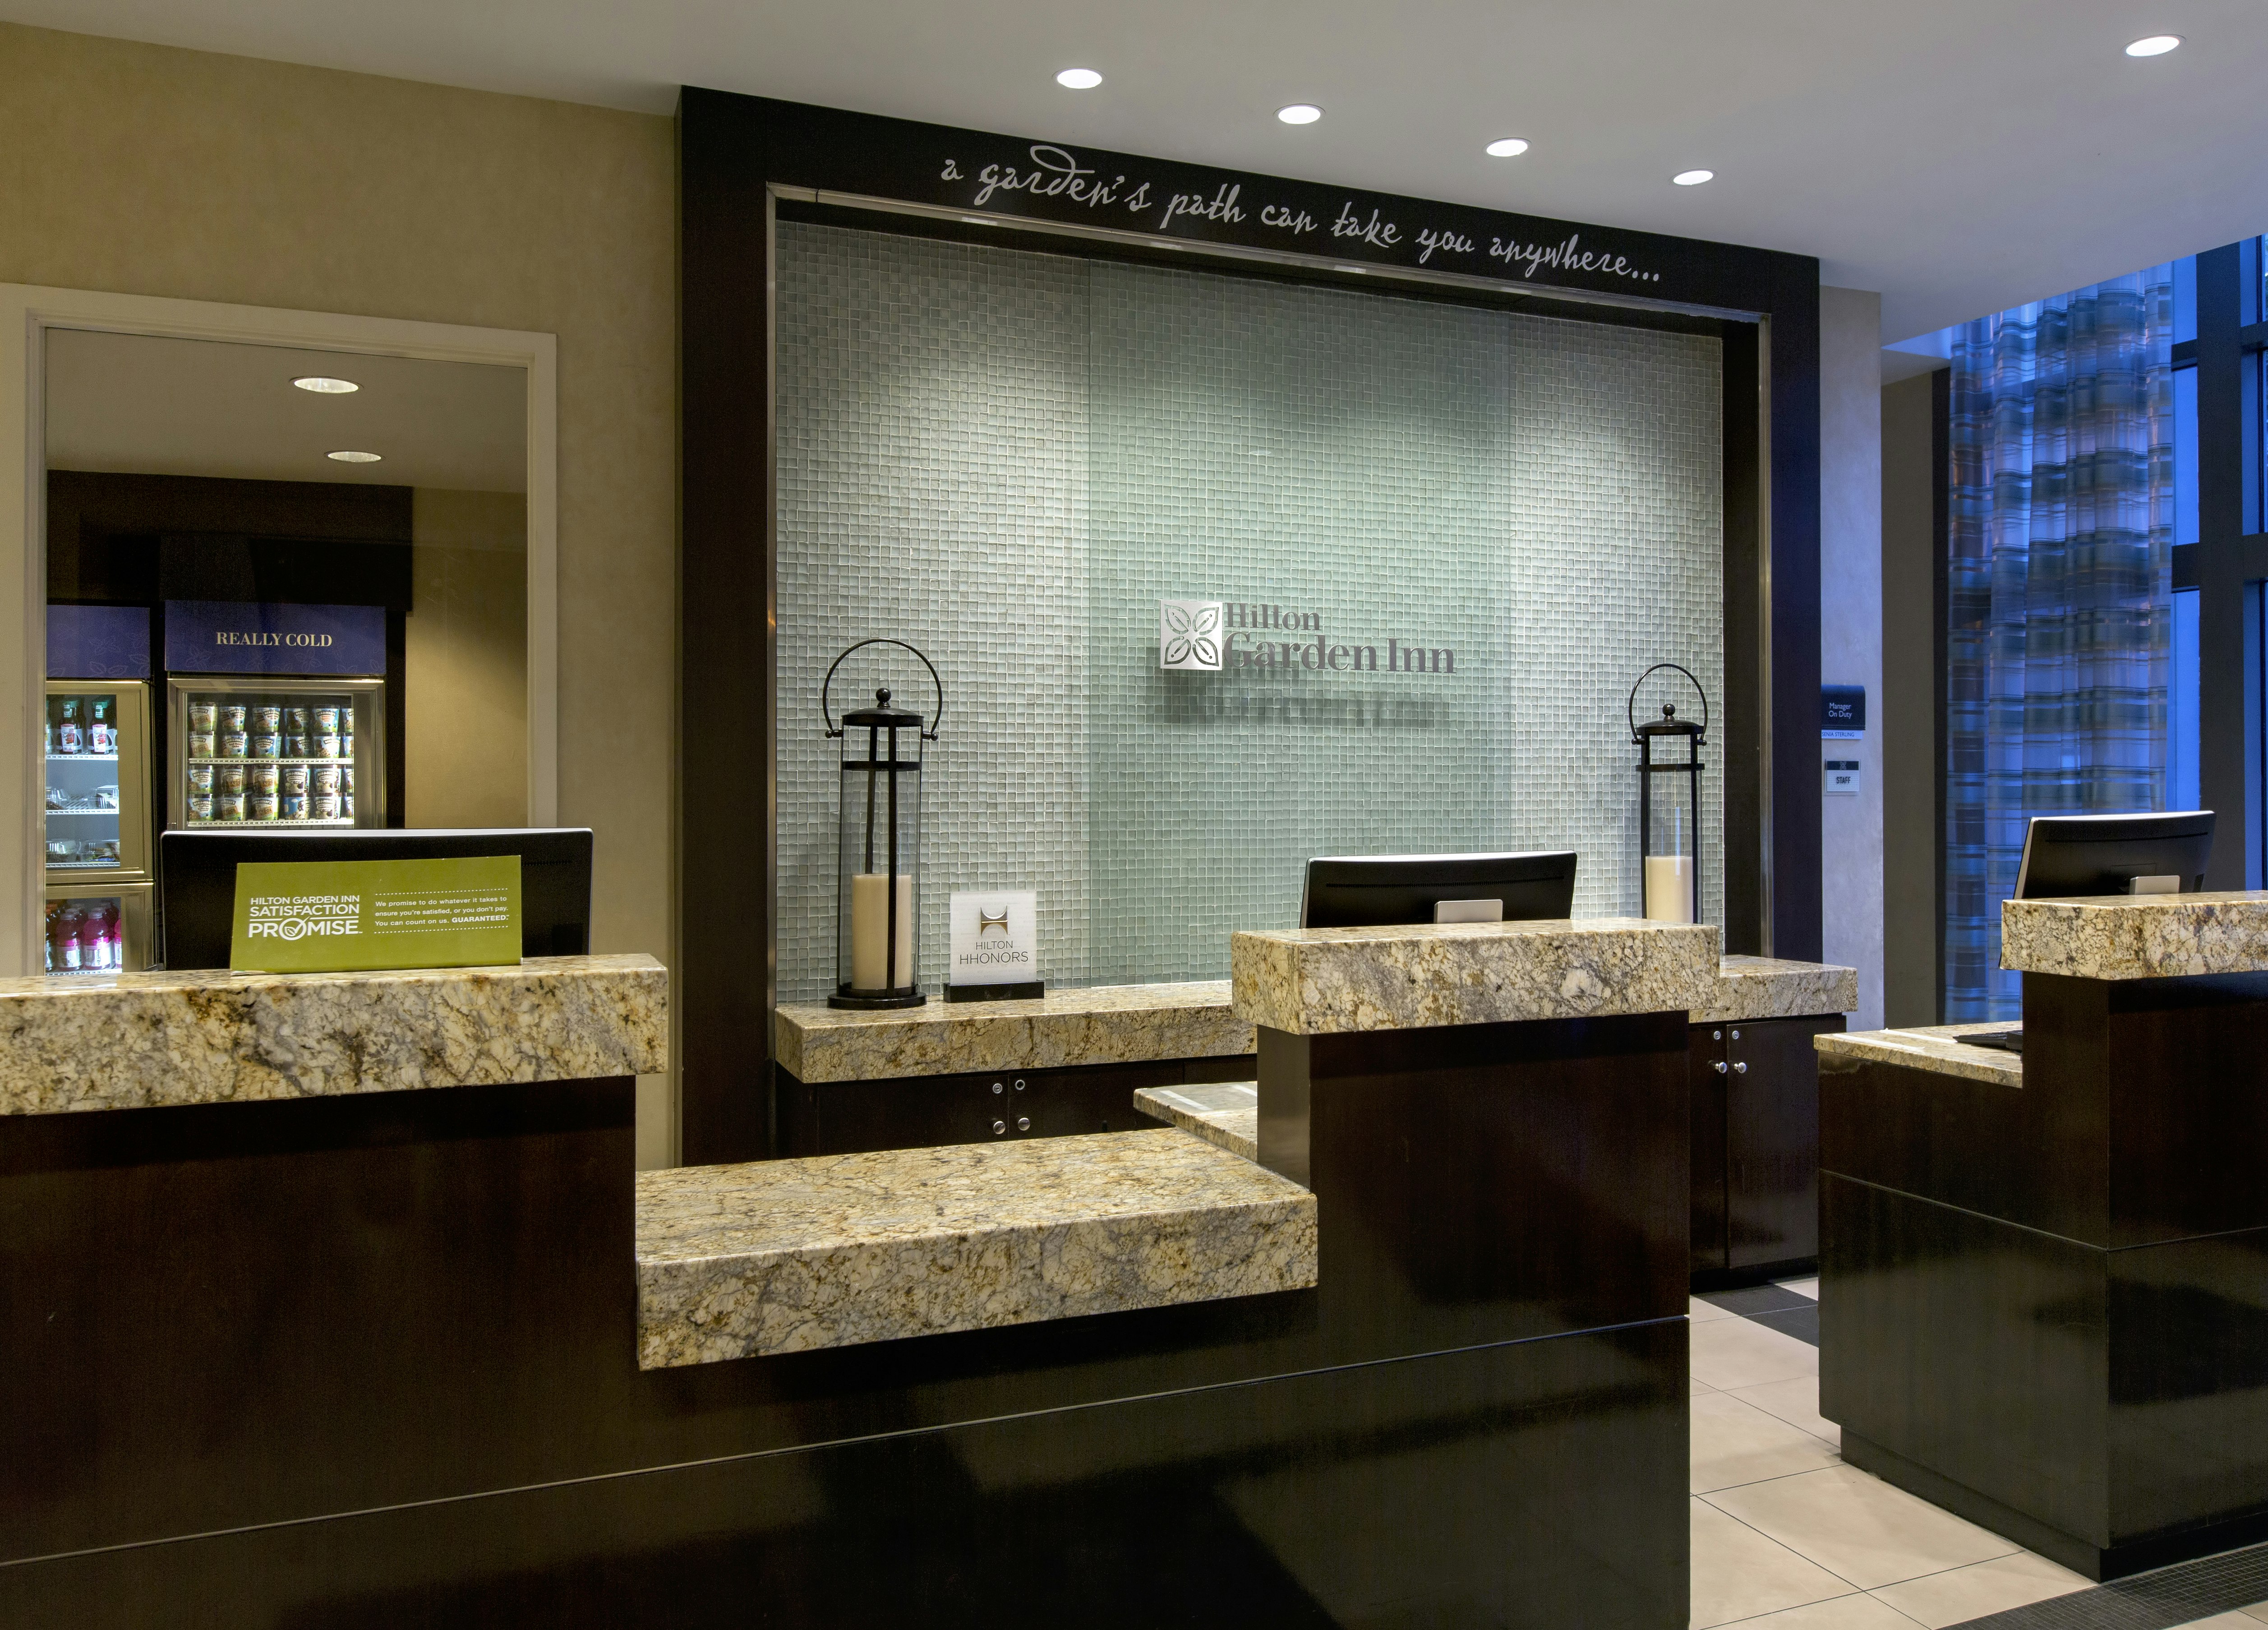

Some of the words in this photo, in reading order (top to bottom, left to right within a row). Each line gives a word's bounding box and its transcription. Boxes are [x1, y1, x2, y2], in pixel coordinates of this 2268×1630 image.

[941, 159, 964, 180] a
[974, 145, 1152, 212] garden's
[1159, 183, 1246, 229] path
[1261, 205, 1318, 234] can
[1330, 201, 1402, 248] take
[1415, 228, 1475, 264] you
[1225, 602, 1322, 631] Hilton
[216, 632, 283, 646] REALLY
[286, 633, 333, 647] COLD
[1223, 632, 1379, 671] Garden
[1386, 637, 1457, 674] Inn
[1829, 702, 1852, 711] Manager
[1839, 710, 1853, 720] Duty
[1836, 776, 1851, 785] STAFF
[250, 897, 290, 905] HILTON
[293, 896, 339, 905] GARDEN
[341, 895, 360, 903] INN
[249, 904, 360, 917] SATISFACTION
[976, 940, 1013, 950] HILTON
[960, 951, 1029, 965] HHONORS
